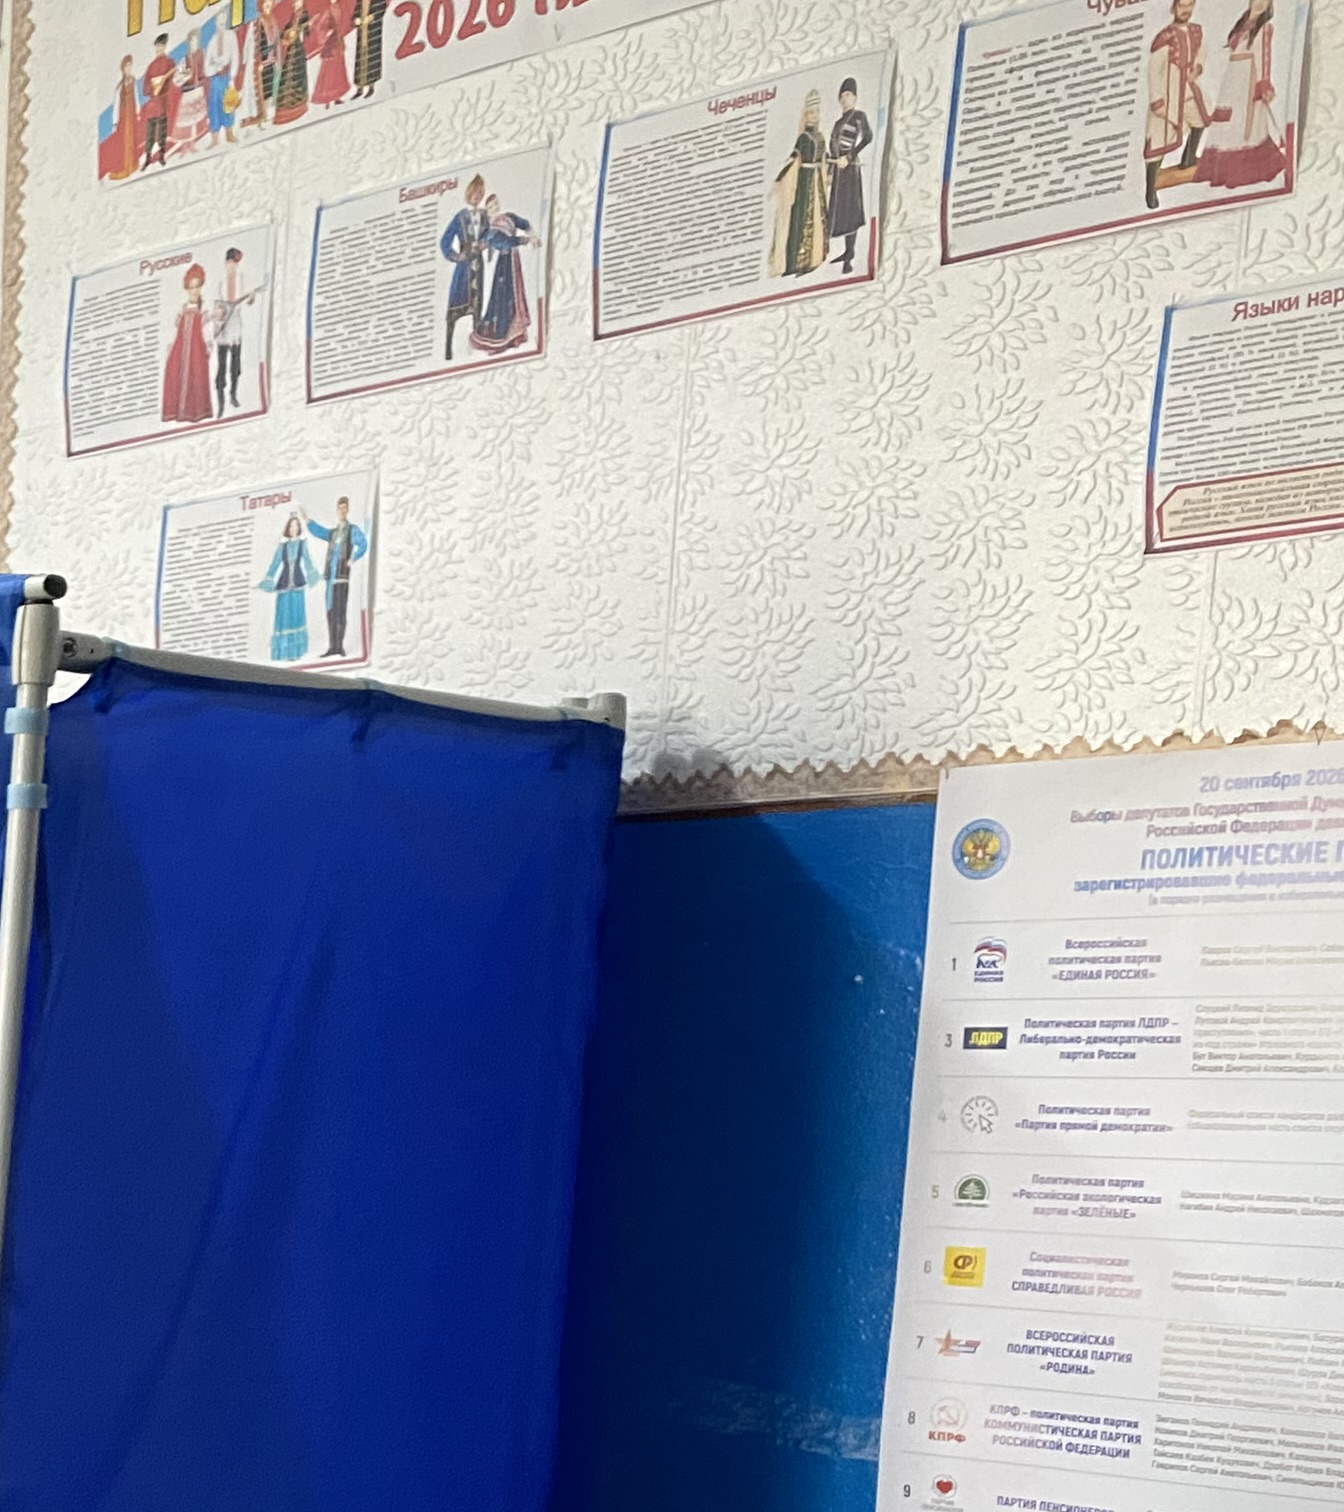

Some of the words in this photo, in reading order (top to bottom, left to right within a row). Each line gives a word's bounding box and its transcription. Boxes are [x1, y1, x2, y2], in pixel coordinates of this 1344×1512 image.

[708, 86, 777, 115] Чеченцы
[397, 175, 459, 203] Башкиры
[139, 250, 192, 275] Русские
[1232, 295, 1300, 321] Языки
[239, 488, 292, 512] Татары
[1200, 776, 1220, 793] 20
[1223, 771, 1301, 791] сентября
[1070, 809, 1122, 823] Выборы
[1146, 819, 1227, 838] Российской
[1140, 840, 1330, 871] ПОЛИТИЧЕСКИЕ
[952, 957, 957, 971] 1
[1051, 969, 1102, 982] «ЕДИНАЯ
[1138, 1017, 1170, 1029] ЛДПР
[944, 1034, 952, 1048] 3
[969, 1030, 1004, 1047] ЛДПР
[1097, 1049, 1136, 1060] России
[931, 1184, 939, 1199] 5
[924, 1260, 932, 1274] 6
[1011, 1280, 1095, 1296] СПРАВЕДЛИВАЯ
[916, 1335, 924, 1349] 7
[1026, 1329, 1115, 1347] ВСЕРОССИЙСКАЯ
[1006, 1343, 1088, 1360] ПОЛИТИЧЕСКАЯ
[1091, 1351, 1133, 1364] ПАРТИЯ
[1039, 1361, 1095, 1376] «РОДИНА»
[908, 1411, 916, 1425] 8
[990, 1404, 1020, 1417] КПРФ
[928, 1430, 966, 1444] КПРФ
[984, 1418, 1098, 1440] КОММУНИСТИЧЕСКАЯ
[1100, 1430, 1142, 1445] ПАРТИЯ
[992, 1433, 1062, 1451] РОССИЙСКОЙ
[1065, 1441, 1130, 1459] ФЕДЕРАЦИИ
[903, 1483, 911, 1498] 9
[996, 1495, 1037, 1510] ПАРТИЯ
